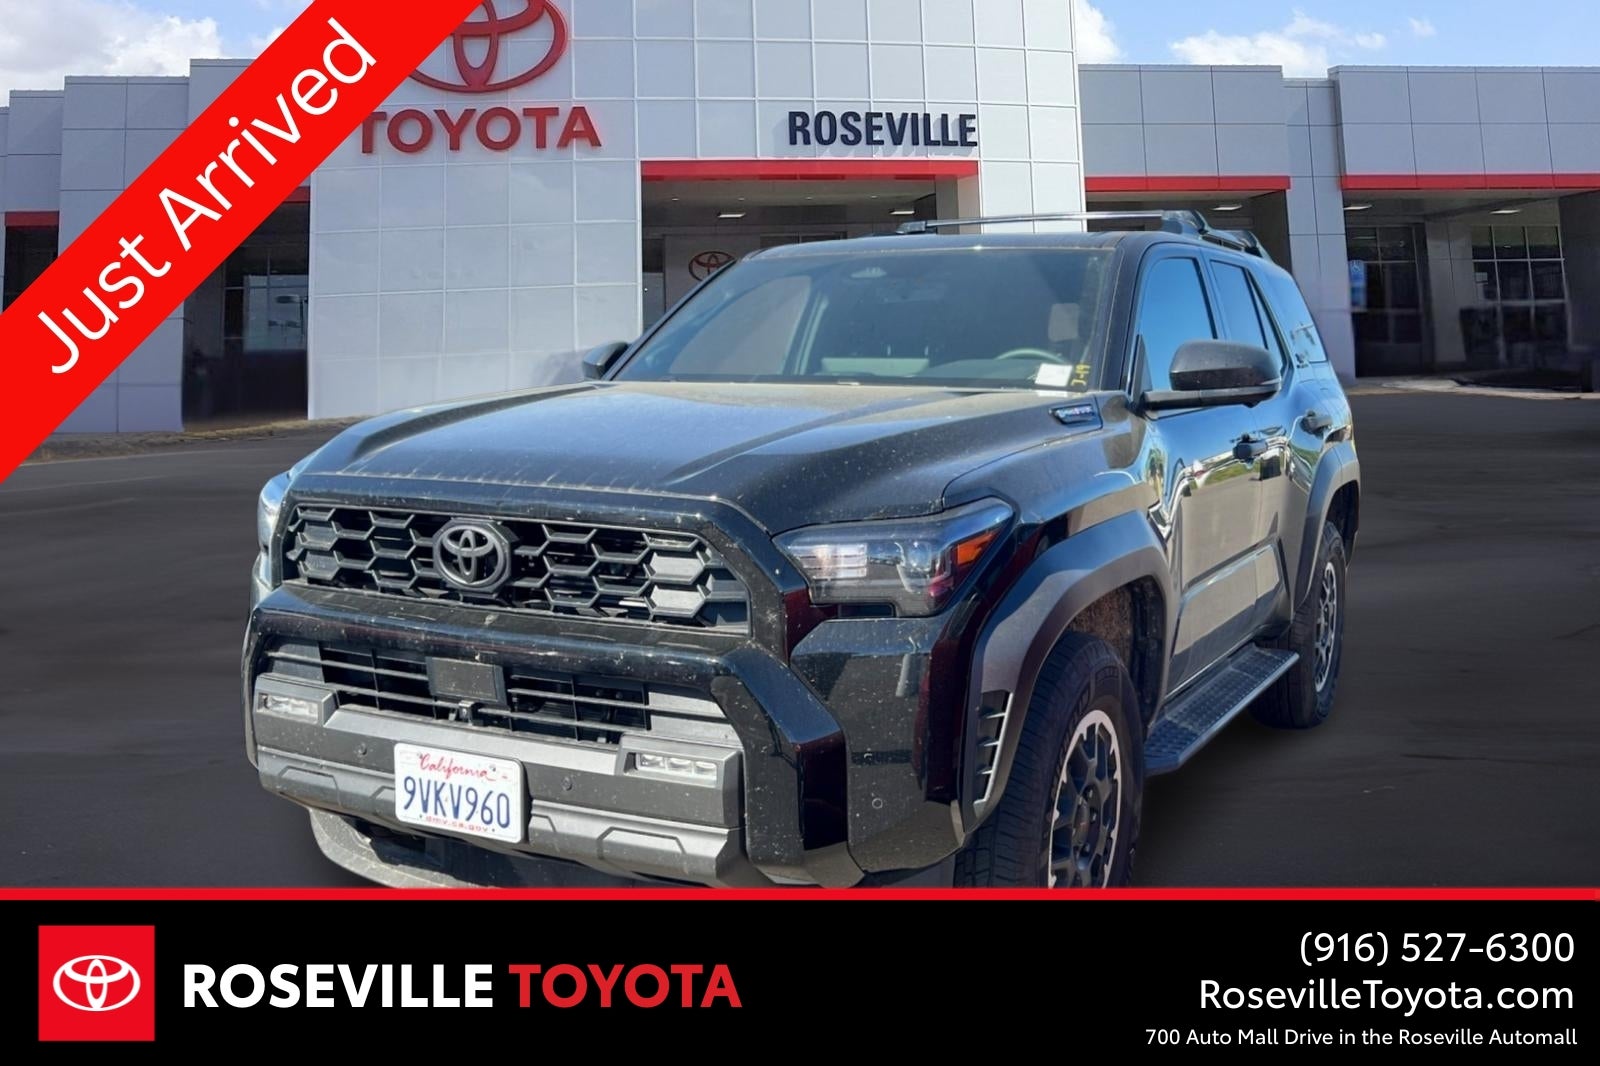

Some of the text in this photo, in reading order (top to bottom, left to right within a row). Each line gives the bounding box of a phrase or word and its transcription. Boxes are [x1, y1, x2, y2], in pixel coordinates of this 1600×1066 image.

[360, 106, 602, 154] TOYOTA
[788, 110, 978, 147] ROSEVILLE
[418, 753, 497, 781] California
[403, 776, 511, 829] 9VKV960
